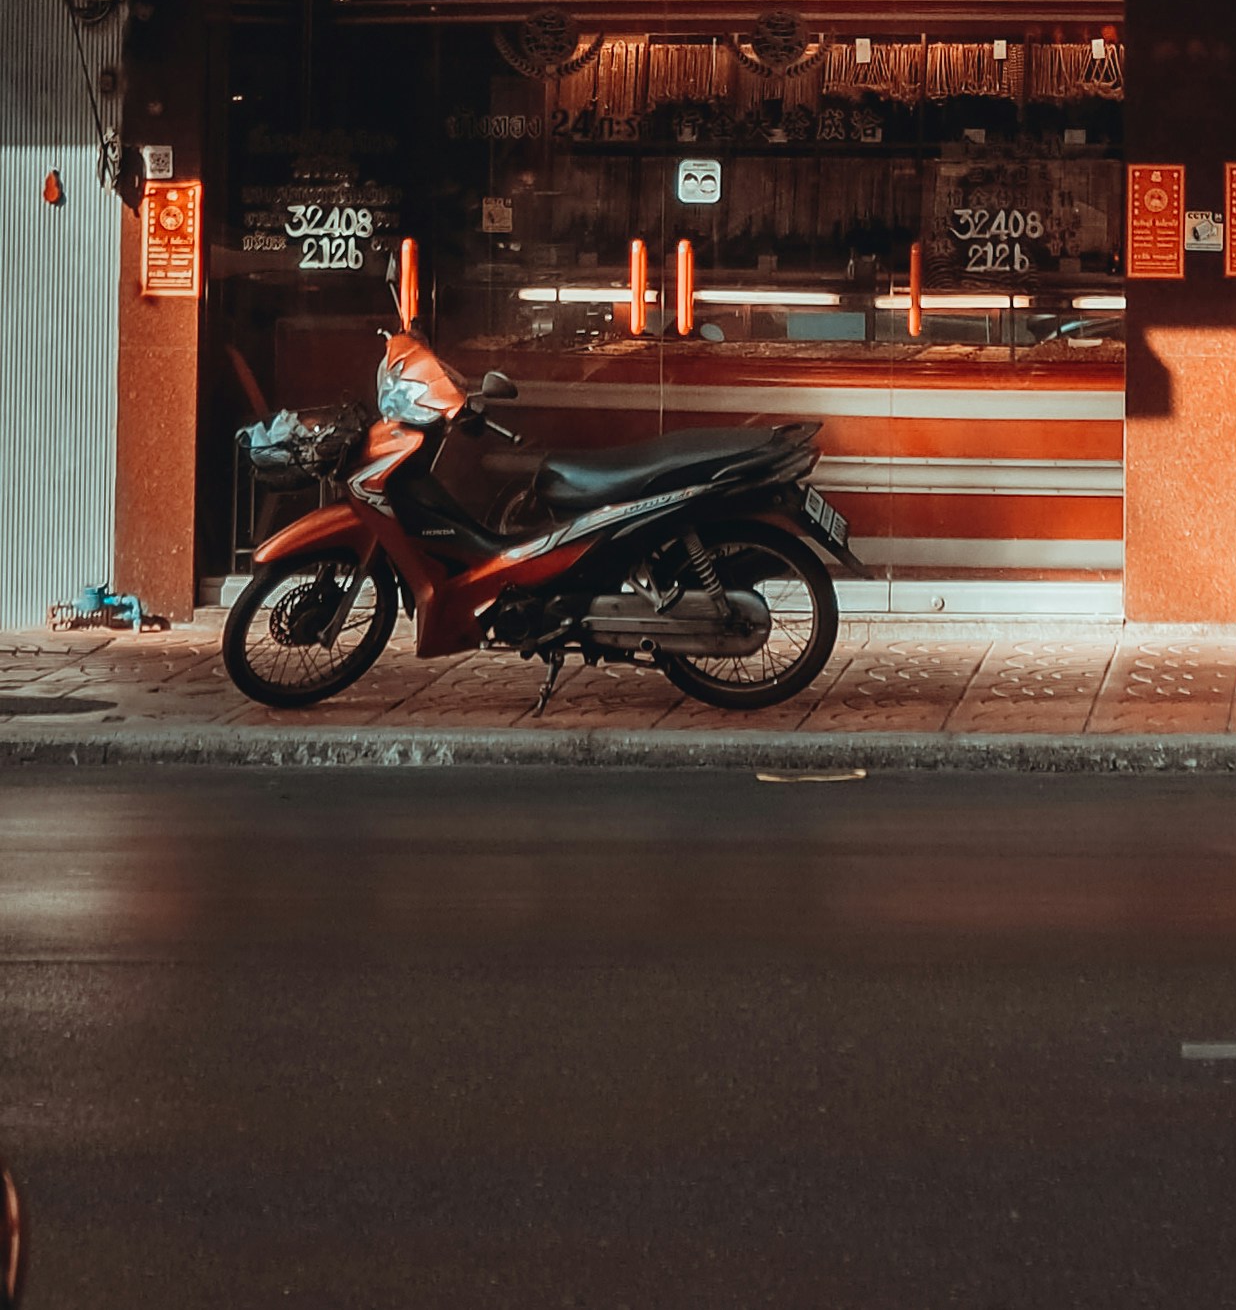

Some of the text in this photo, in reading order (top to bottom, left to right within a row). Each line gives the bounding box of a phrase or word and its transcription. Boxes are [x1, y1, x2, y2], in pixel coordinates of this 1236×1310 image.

[284, 205, 374, 238] 32408
[949, 209, 1045, 242] 32408
[1187, 212, 1211, 220] CCTV
